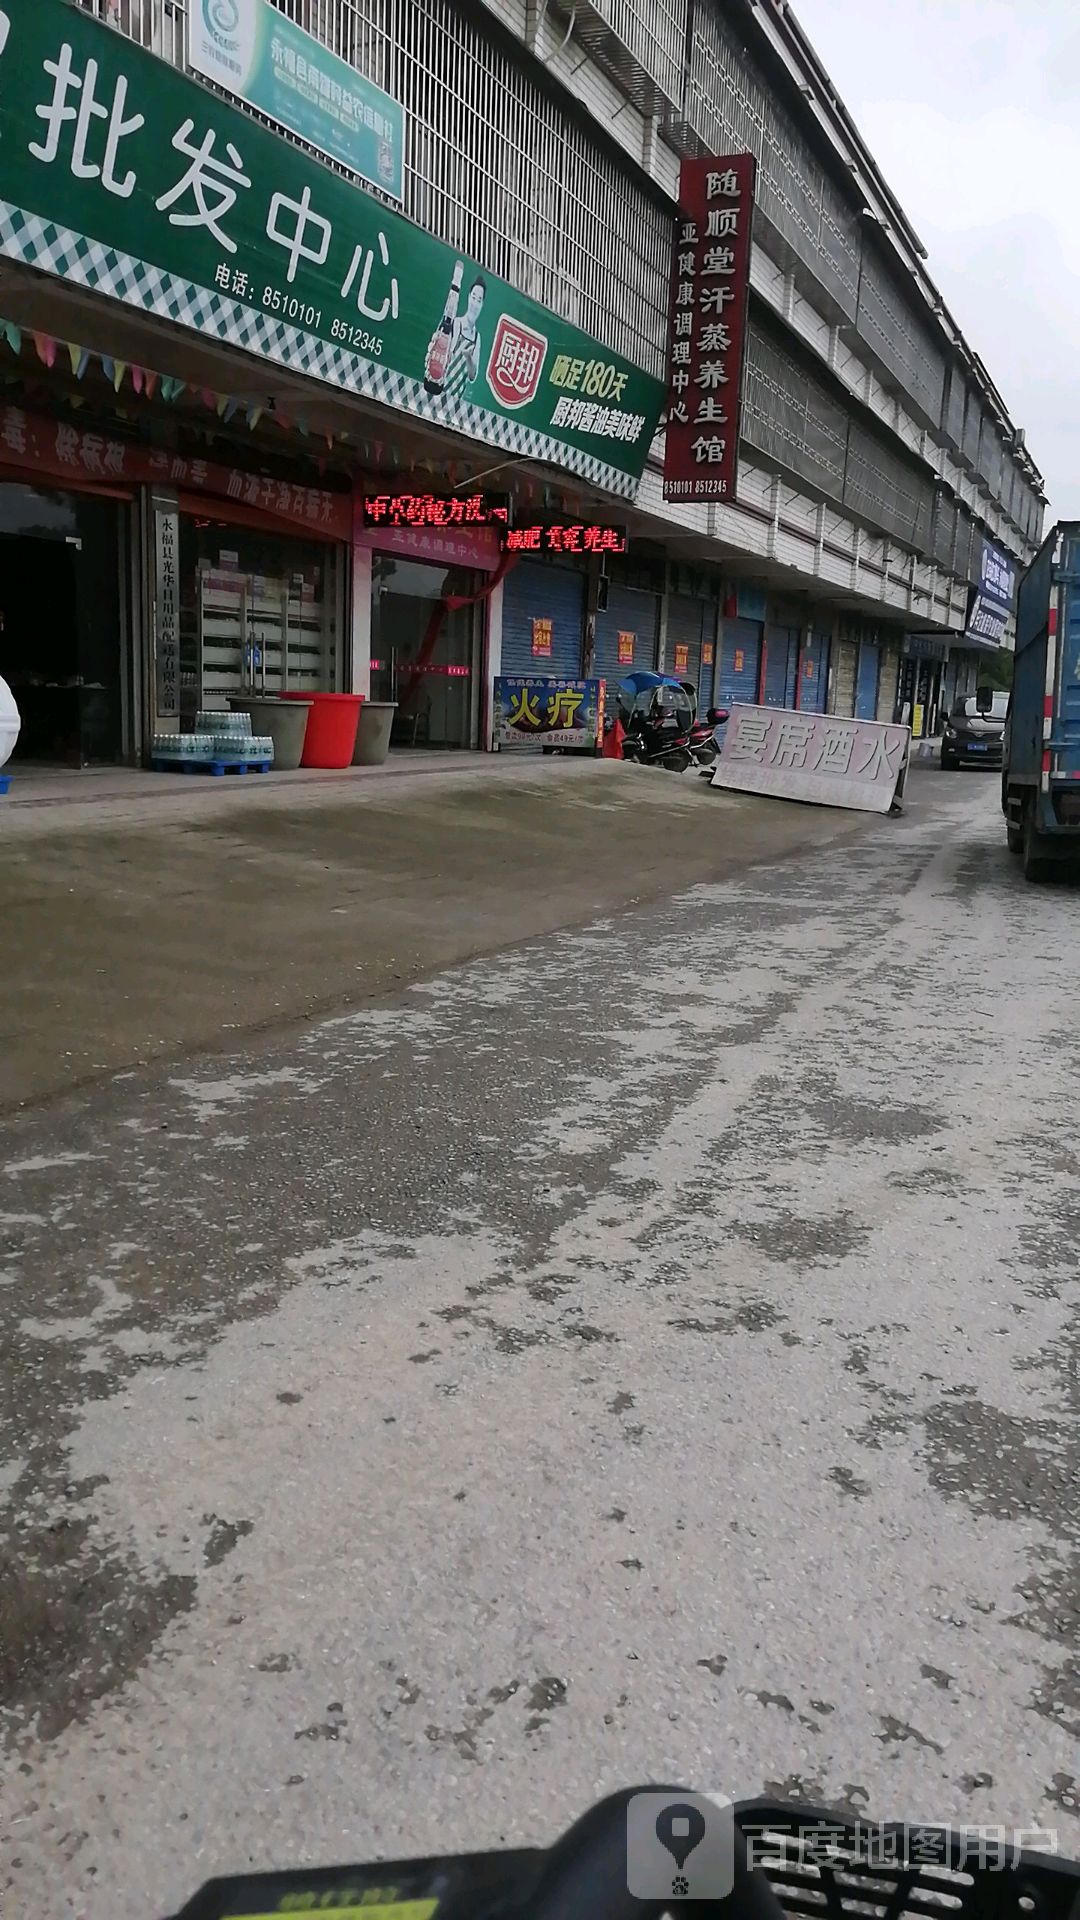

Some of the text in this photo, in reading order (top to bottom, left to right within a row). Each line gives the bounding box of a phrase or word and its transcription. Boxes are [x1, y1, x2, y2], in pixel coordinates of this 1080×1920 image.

[0, 9, 399, 321] 批发中心
[330, 318, 384, 356] 8512345
[669, 222, 700, 424] 亚健康调理中心
[690, 168, 742, 464] 随顺堂汗蒸养生馆
[494, 330, 541, 386] 厨邦
[548, 354, 630, 402] 晒足180天
[549, 395, 646, 444] 厨邦酱油美味鲜
[663, 479, 728, 494] 8510101 8512345
[507, 687, 585, 729] 火疗
[729, 709, 901, 781] 宴席酒水
